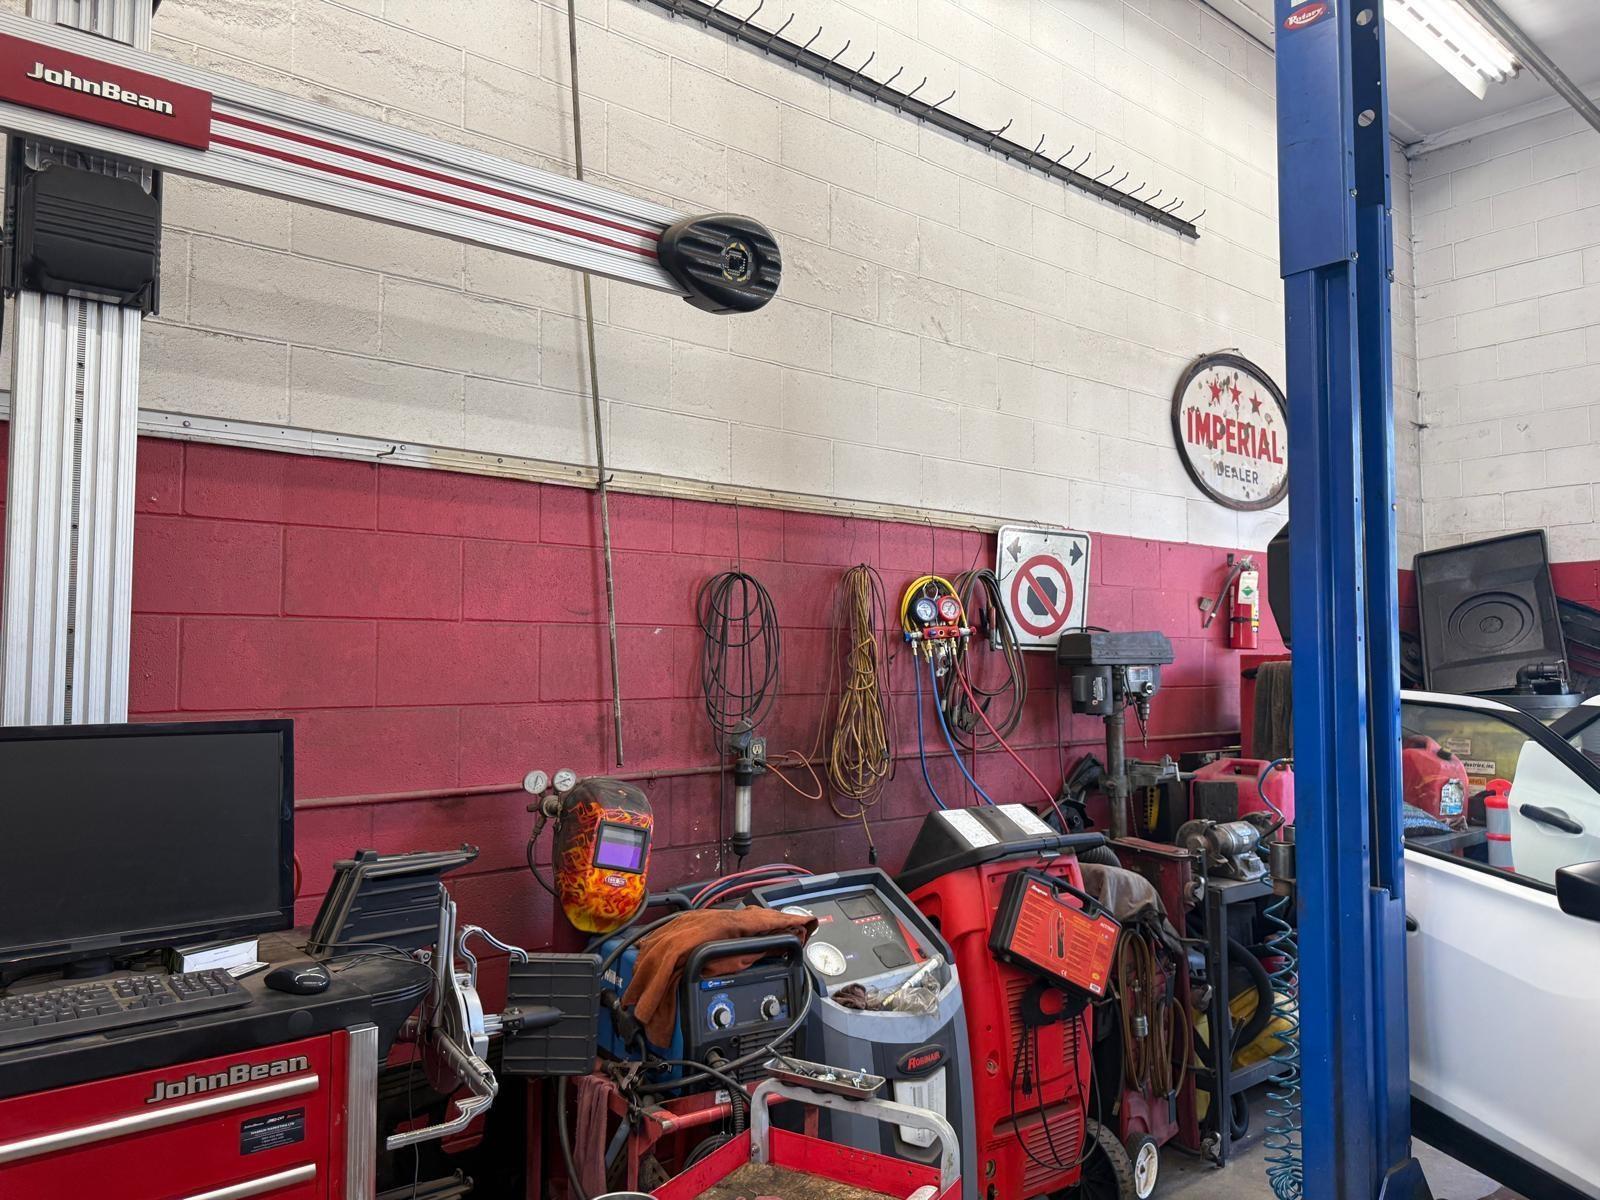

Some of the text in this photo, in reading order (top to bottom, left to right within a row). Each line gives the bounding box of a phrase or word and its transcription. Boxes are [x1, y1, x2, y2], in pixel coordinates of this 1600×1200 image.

[1288, 7, 1323, 25] Rotary
[26, 62, 174, 115] JohnBean
[1187, 406, 1284, 465] IMPERIAL
[1216, 464, 1259, 485] DEALER
[907, 1051, 941, 1072] ROBINAIR
[146, 1055, 311, 1104] JohnBean
